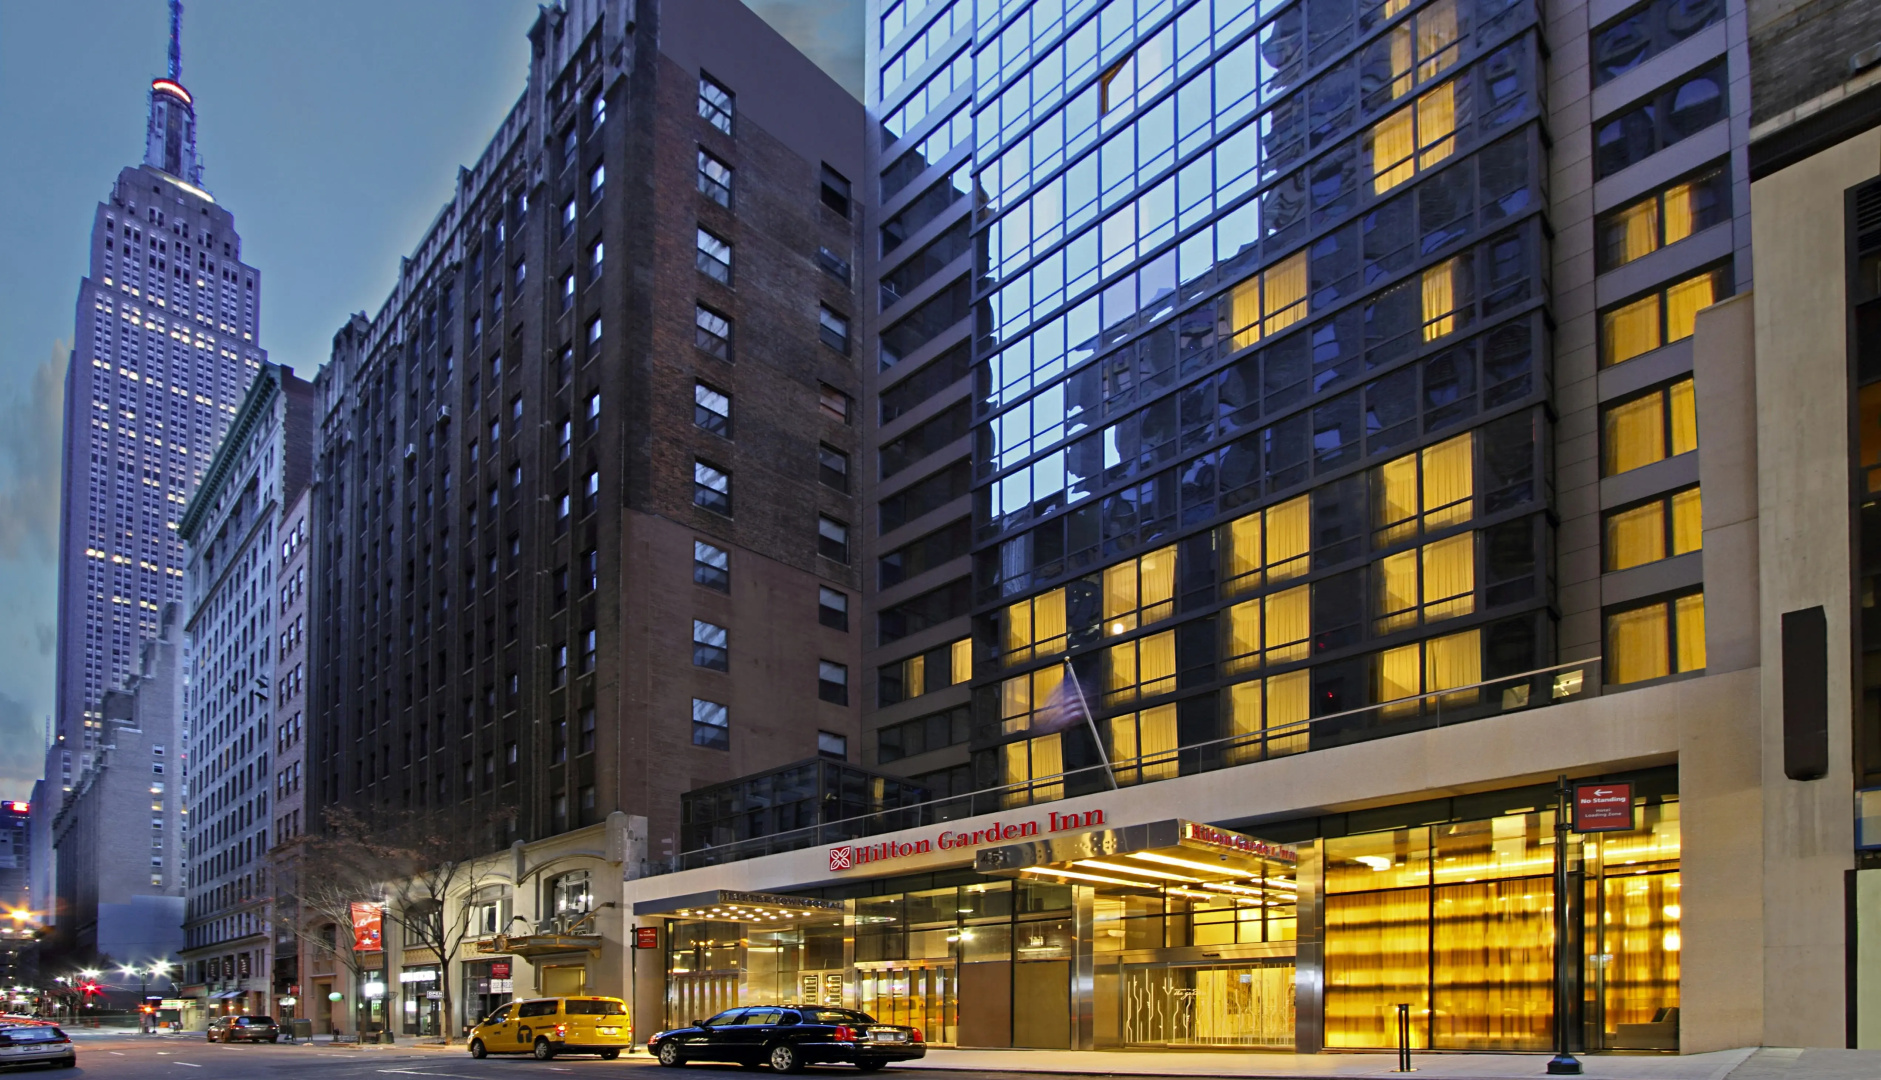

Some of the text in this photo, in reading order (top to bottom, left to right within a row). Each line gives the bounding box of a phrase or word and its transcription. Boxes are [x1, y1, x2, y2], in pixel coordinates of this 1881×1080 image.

[855, 808, 1105, 865] Hilton Garden Inn
[1192, 823, 1233, 846] Hilton
